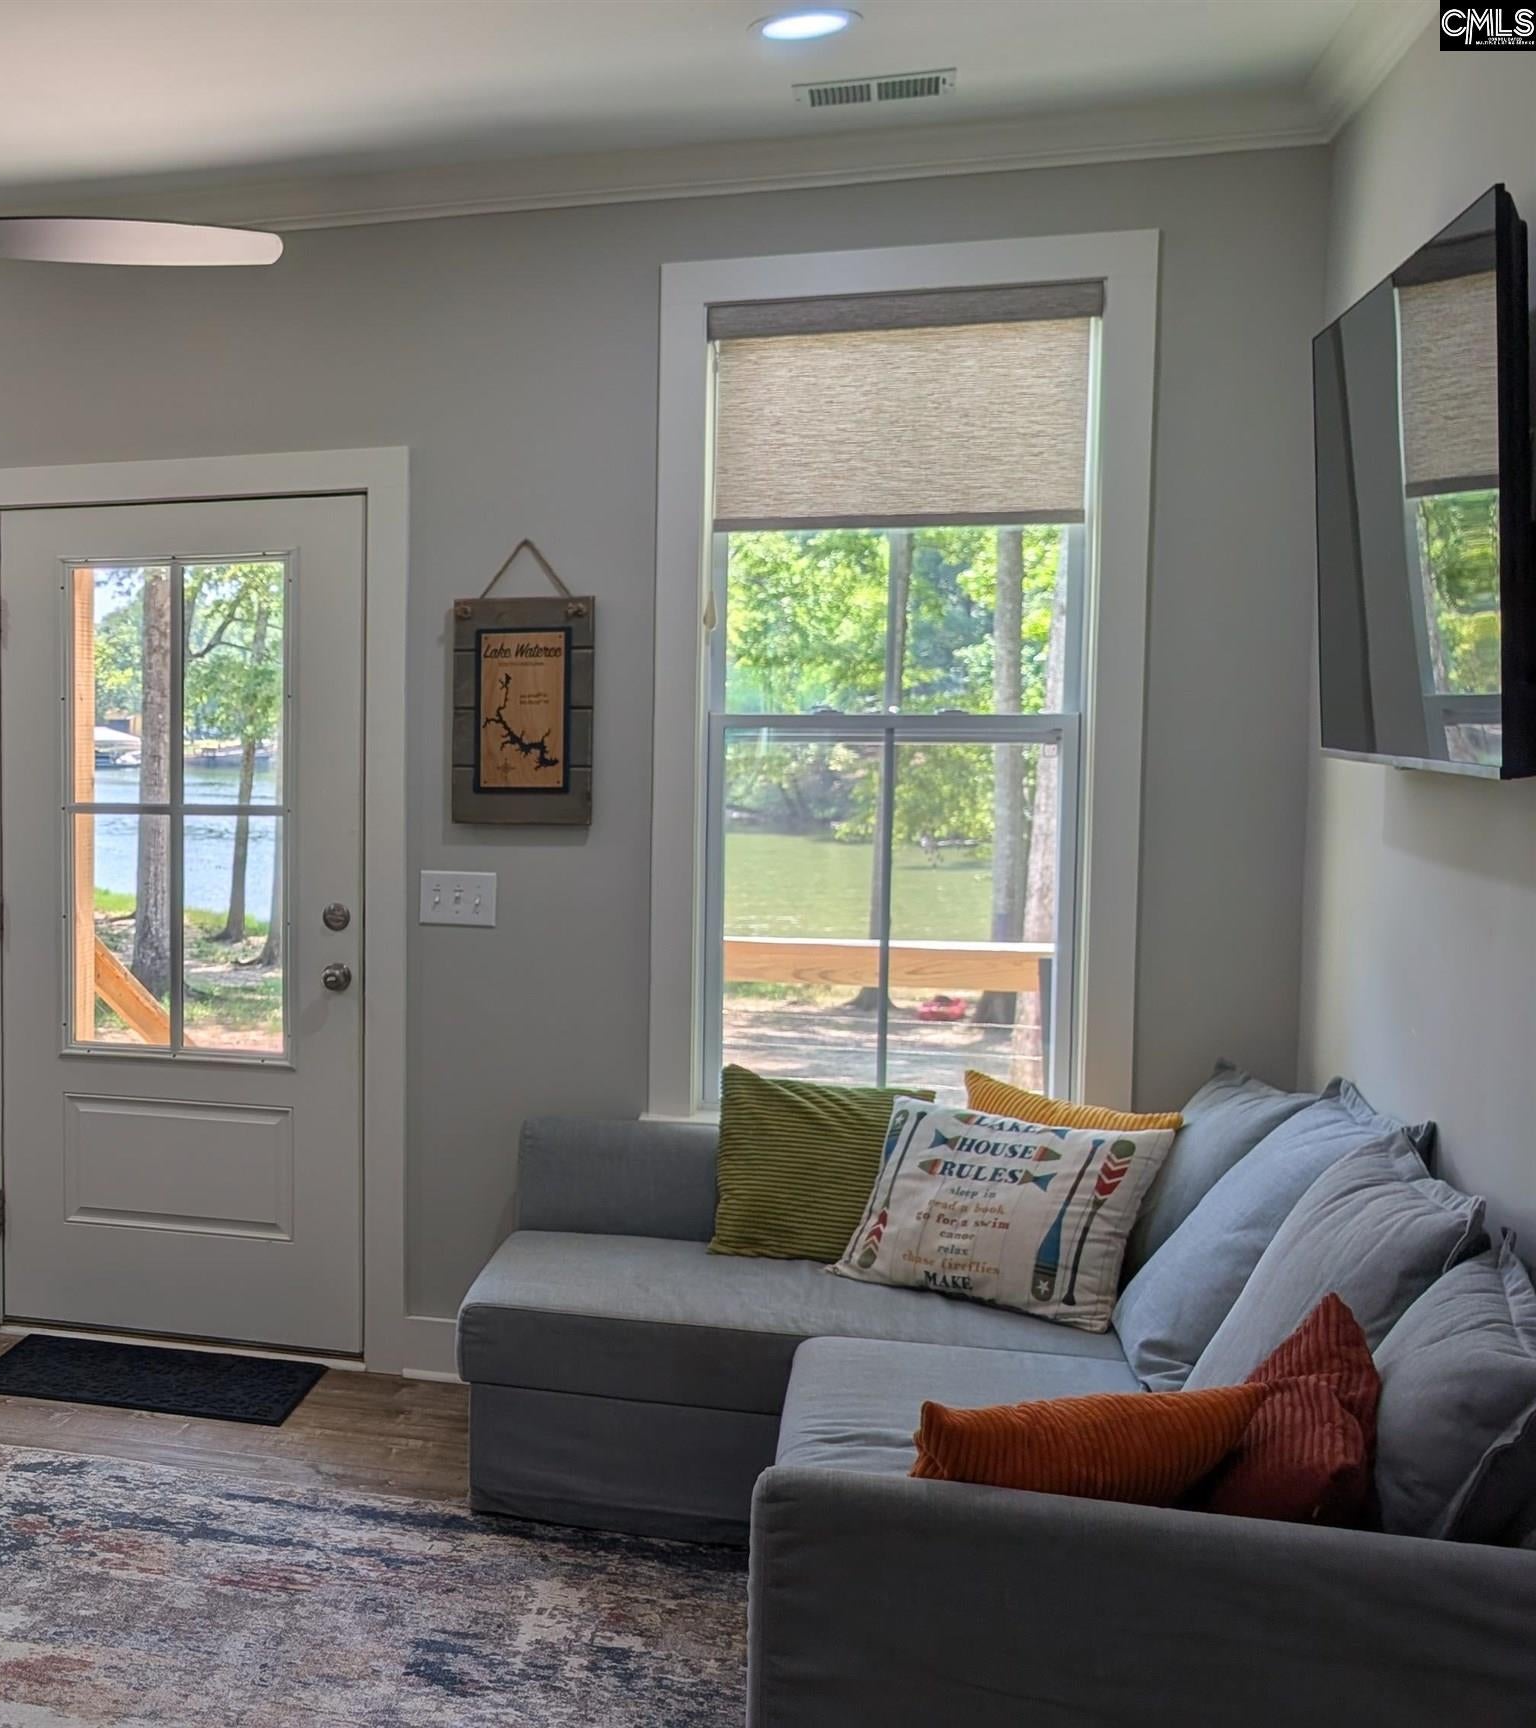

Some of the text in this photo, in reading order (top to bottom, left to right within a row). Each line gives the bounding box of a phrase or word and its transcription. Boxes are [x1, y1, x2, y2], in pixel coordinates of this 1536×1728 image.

[483, 642, 562, 659] Lake Wateree
[974, 1115, 1041, 1134] LAKE
[956, 1136, 1038, 1160] HOUSE
[939, 1160, 1023, 1184] RULES
[950, 1186, 997, 1199] sleep in
[974, 1202, 1005, 1215] book
[936, 1213, 955, 1226] for
[974, 1217, 1010, 1230] swim
[937, 1244, 970, 1257] relax
[940, 1257, 1001, 1276] fireflies
[924, 1270, 974, 1291] MAKE
